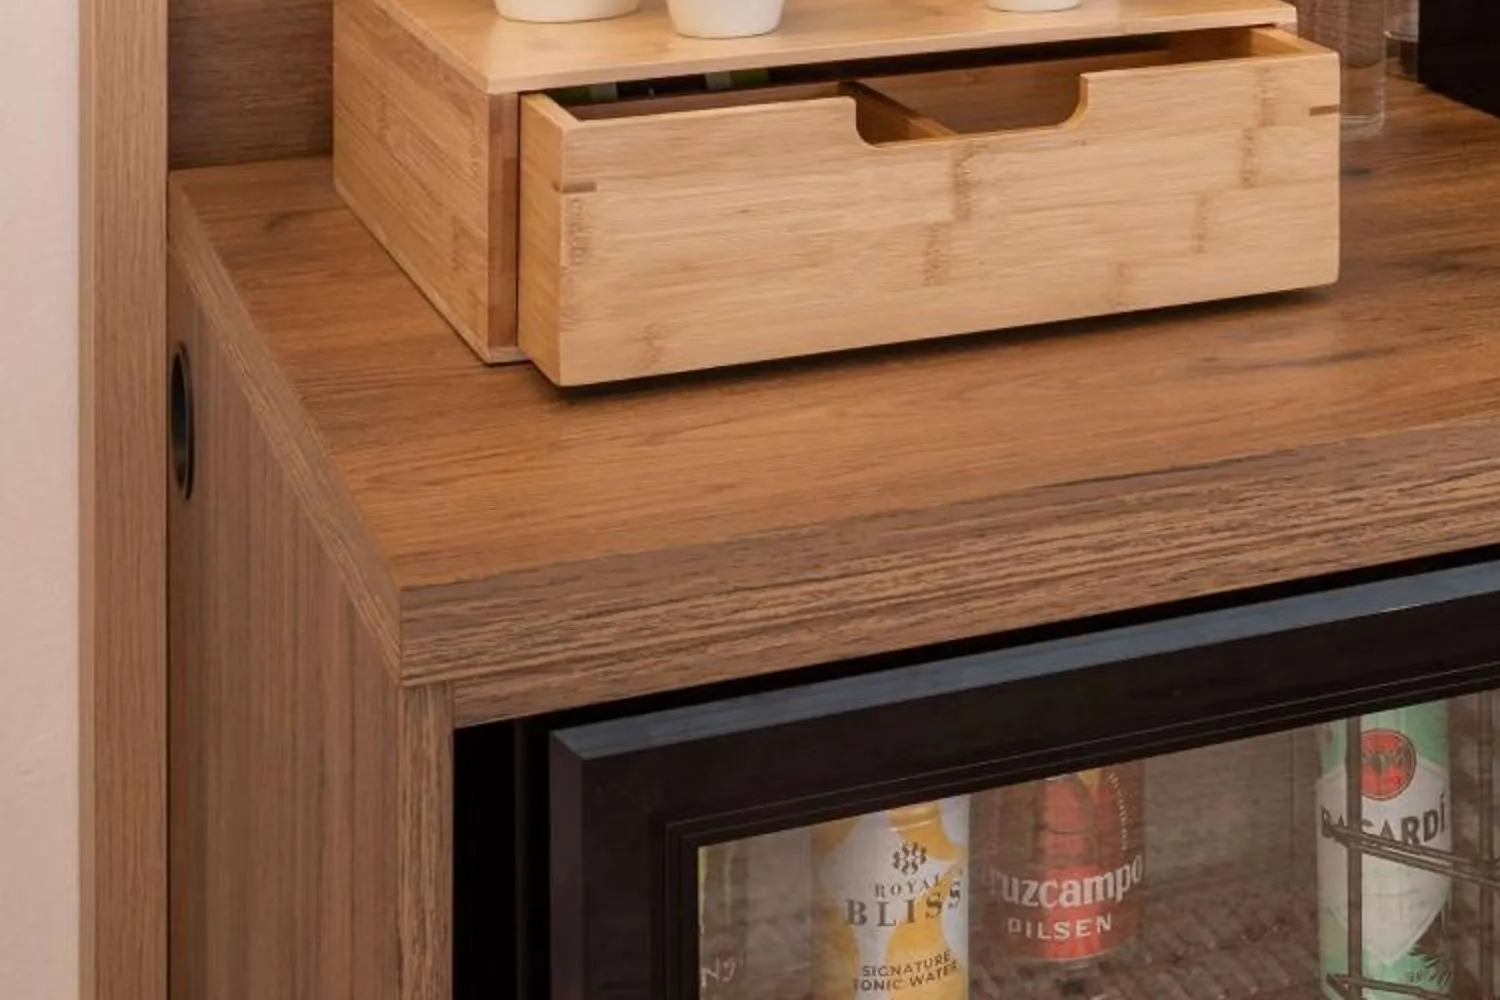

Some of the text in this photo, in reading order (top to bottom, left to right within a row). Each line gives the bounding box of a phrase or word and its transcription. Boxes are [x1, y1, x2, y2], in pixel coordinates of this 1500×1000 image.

[875, 875, 941, 898] ROYAL
[1008, 914, 1112, 941] PILSEN
[862, 951, 951, 978] SIGNATURE
[853, 978, 904, 992] TONIC
